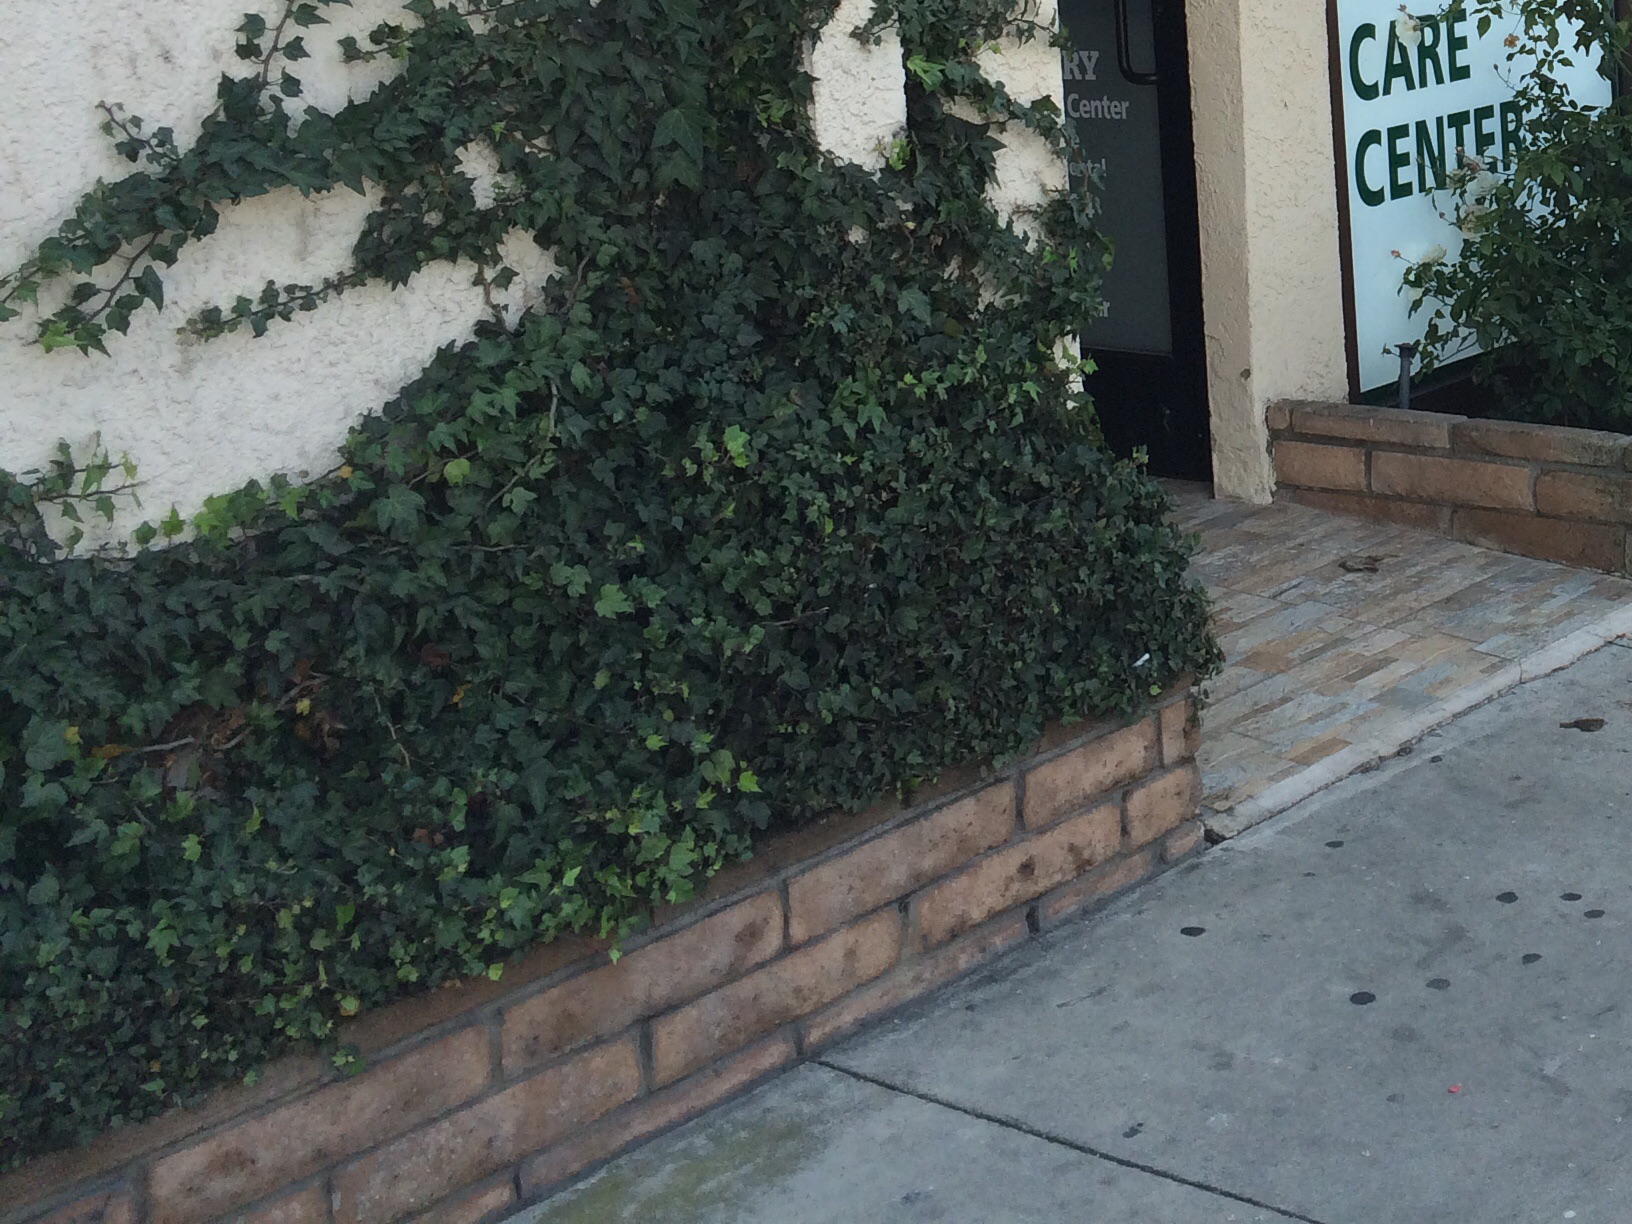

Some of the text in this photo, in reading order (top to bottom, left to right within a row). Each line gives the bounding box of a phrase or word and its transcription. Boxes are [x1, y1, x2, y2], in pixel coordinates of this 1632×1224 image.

[1349, 5, 1471, 101] CARE
[1067, 92, 1130, 120] Center
[1355, 100, 1524, 208] CENTER
